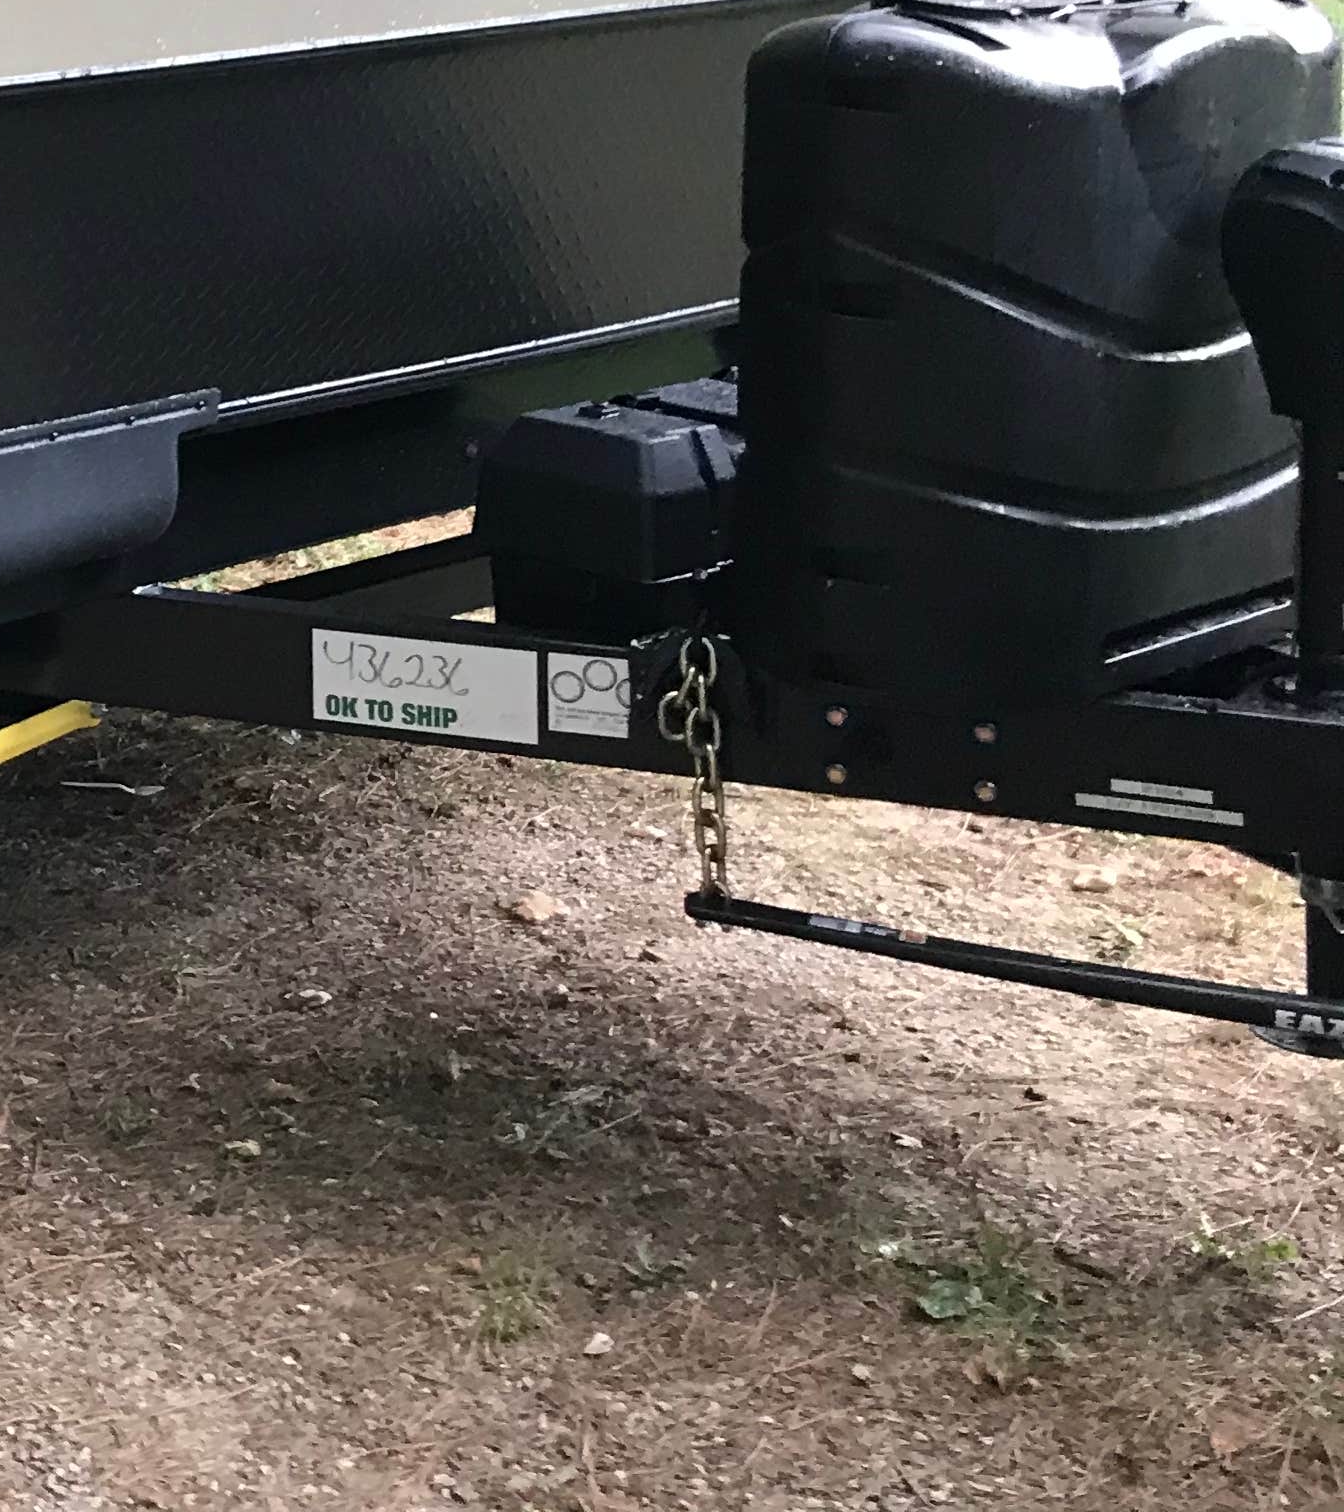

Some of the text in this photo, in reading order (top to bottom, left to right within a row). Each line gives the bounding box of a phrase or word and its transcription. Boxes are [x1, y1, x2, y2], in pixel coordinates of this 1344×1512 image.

[325, 694, 458, 729] OK TO SHIP
